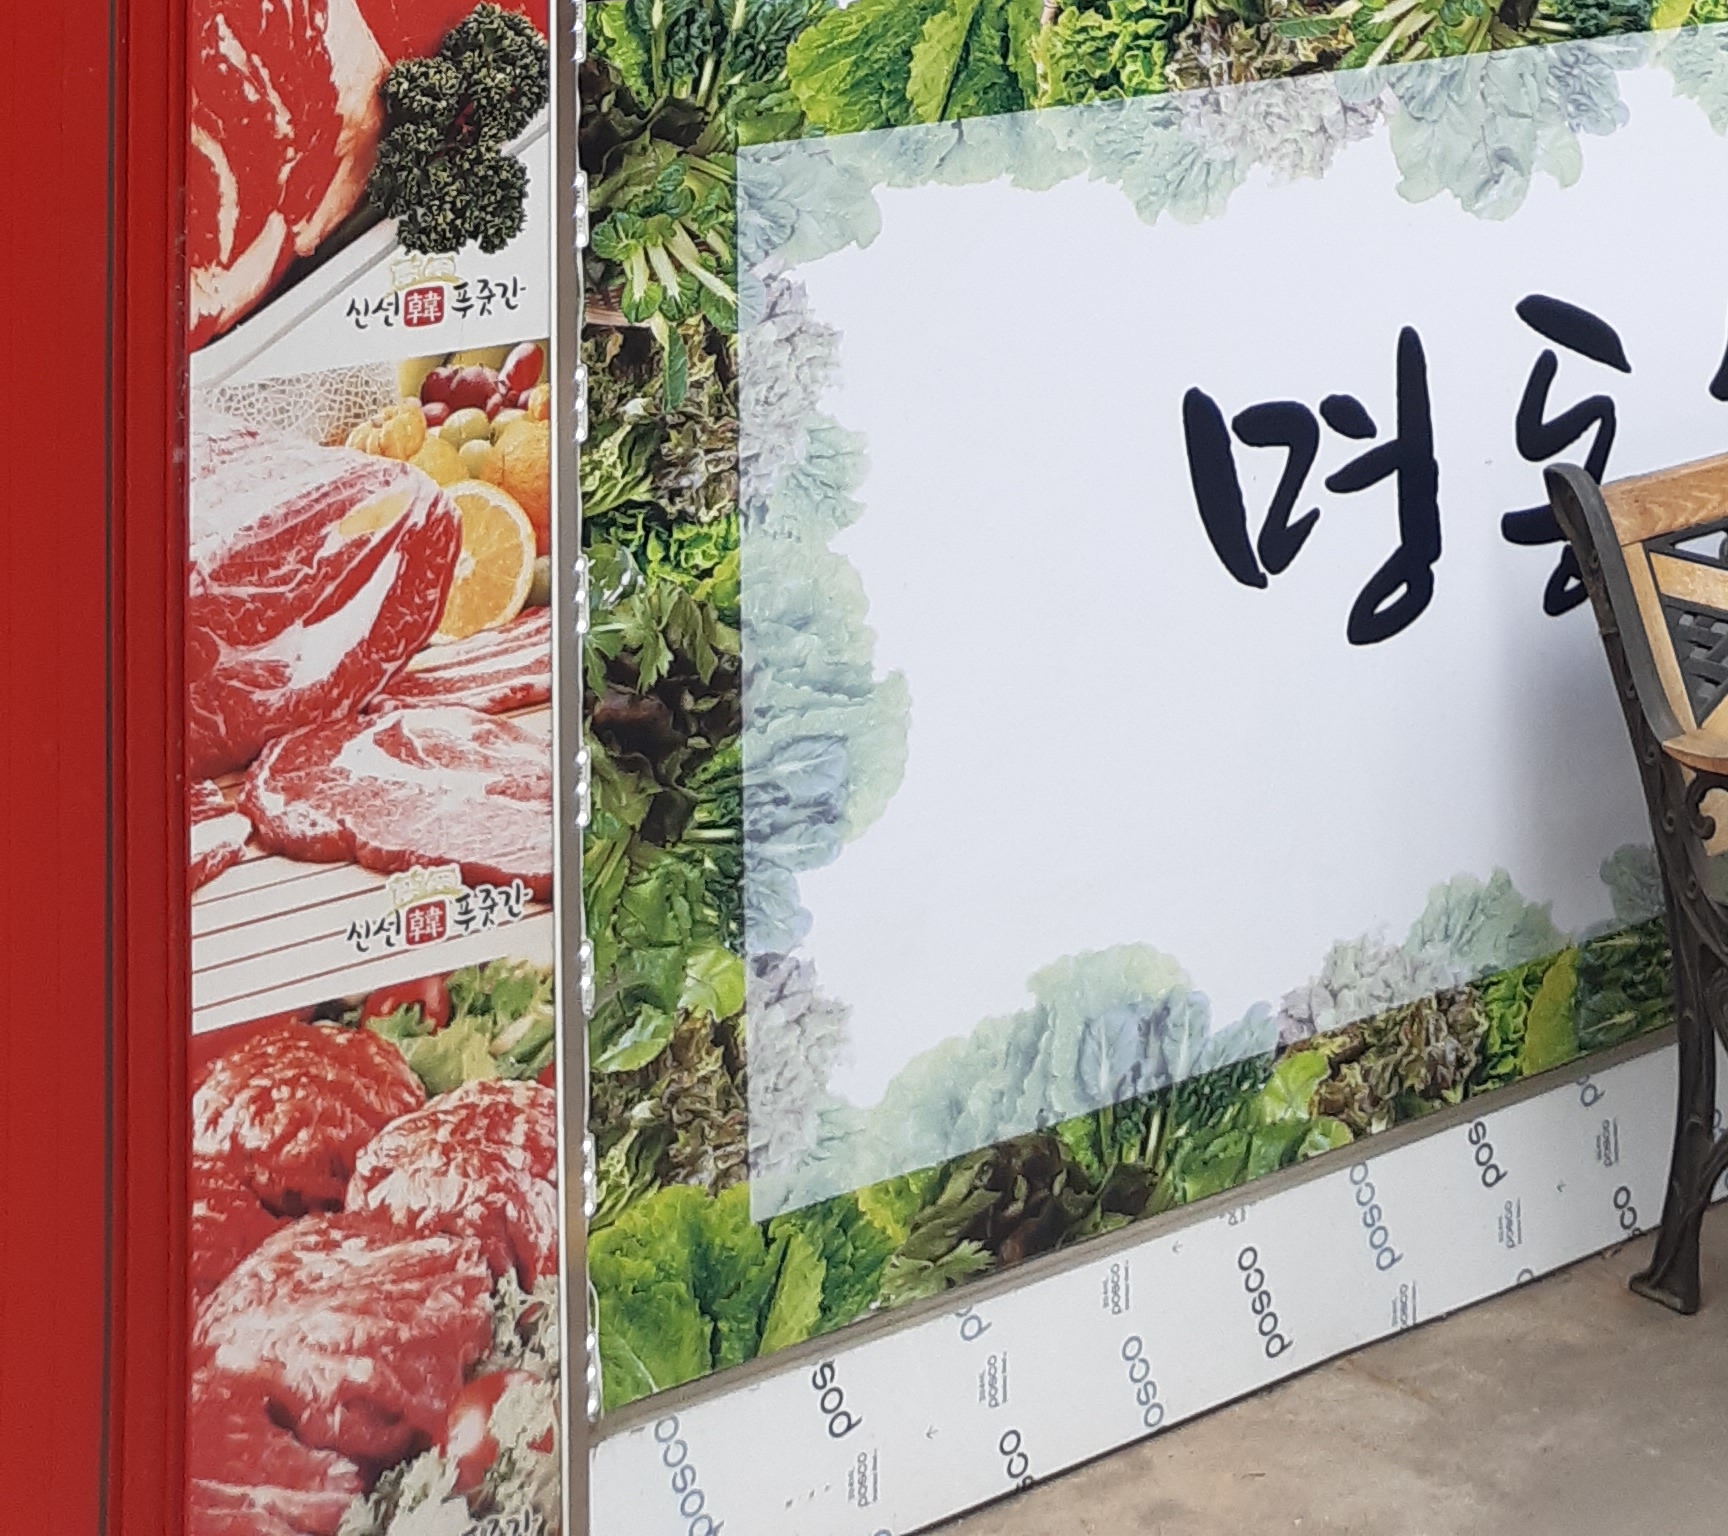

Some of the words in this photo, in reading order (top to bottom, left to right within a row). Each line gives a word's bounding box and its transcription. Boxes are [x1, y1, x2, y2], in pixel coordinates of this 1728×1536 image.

[346, 291, 400, 330] 신선
[451, 275, 527, 320] 푸줏간
[346, 908, 401, 953] 신선
[453, 881, 530, 931] 푸줏간
[1237, 1245, 1294, 1360] posco
